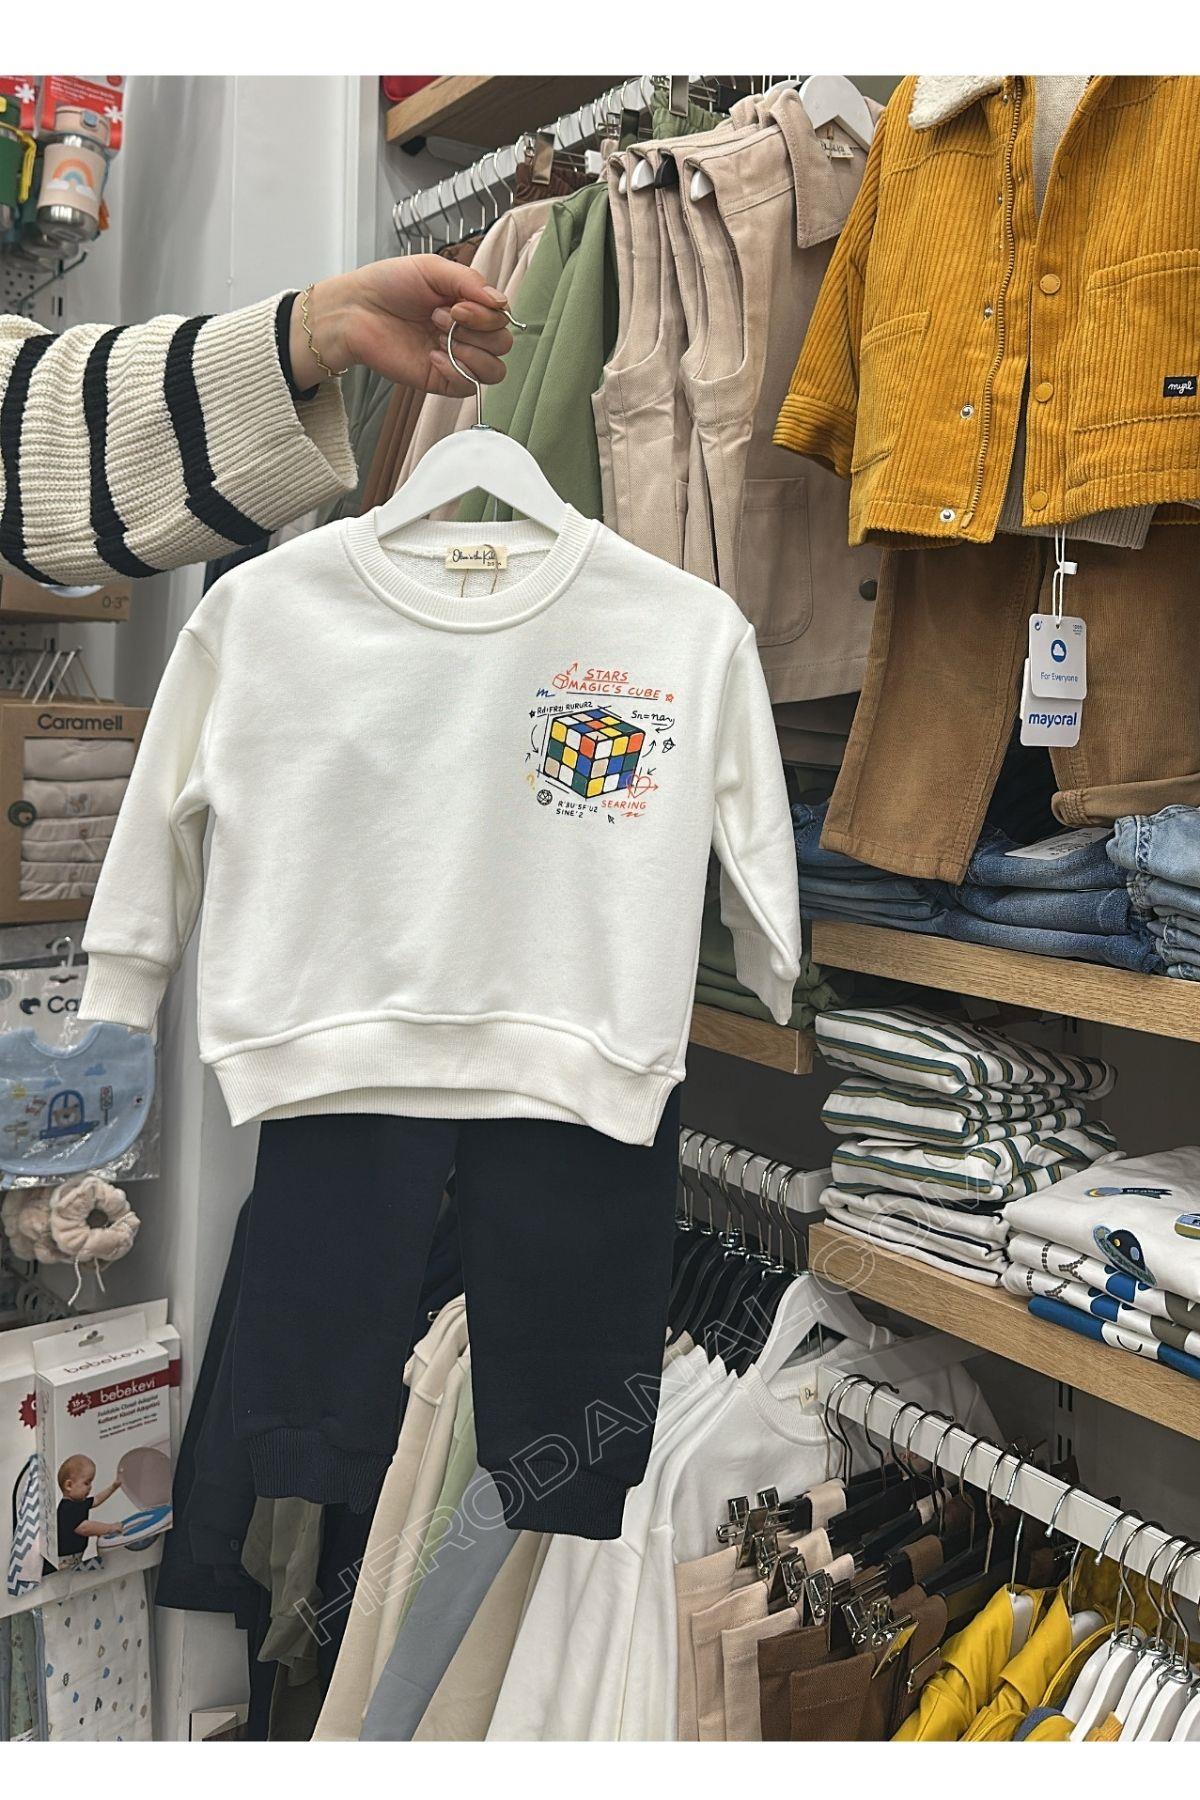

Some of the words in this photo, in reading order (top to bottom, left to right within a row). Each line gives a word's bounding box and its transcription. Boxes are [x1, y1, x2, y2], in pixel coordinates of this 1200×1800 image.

[585, 669, 629, 681] STARS
[1040, 671, 1051, 680] For
[1051, 672, 1079, 682] Everyone
[568, 679, 622, 694] MAGIC'S
[627, 687, 662, 699] CUBE
[37, 713, 123, 730] Caramell
[1028, 712, 1078, 728] mayoral
[600, 800, 647, 809] SEARING
[64, 1348, 145, 1373] bebekevi
[100, 1377, 156, 1402] bebekevi
